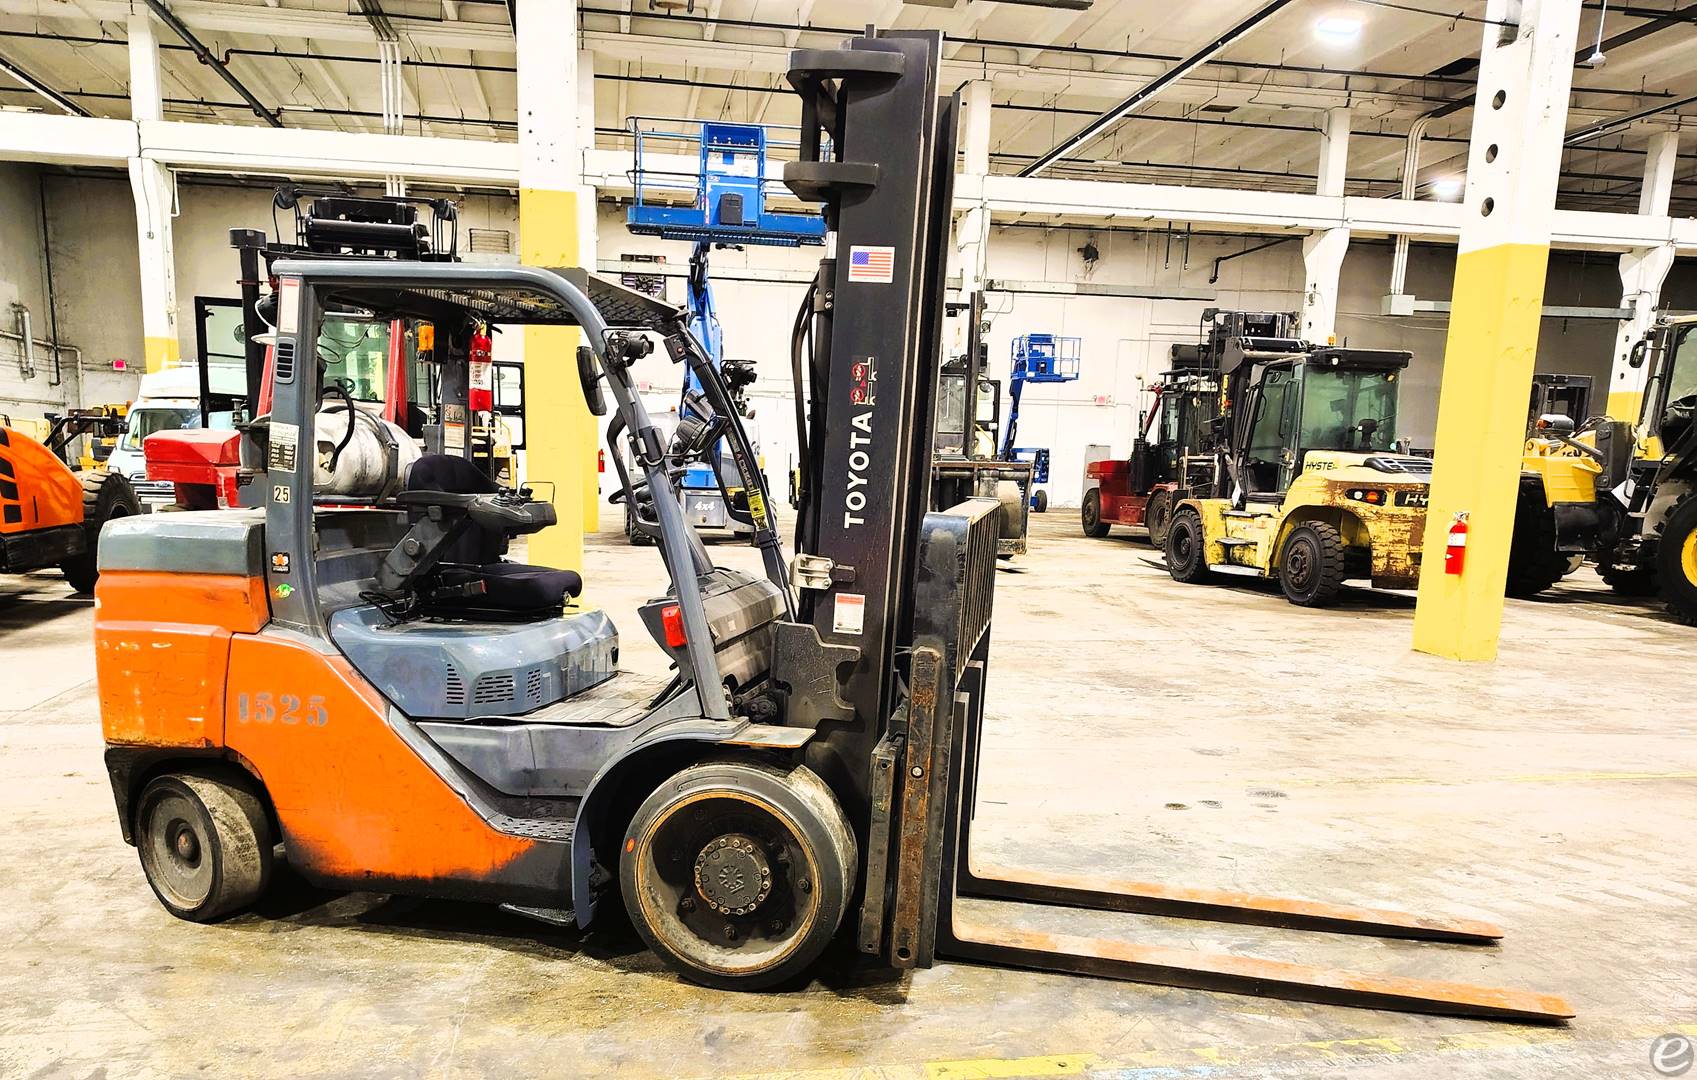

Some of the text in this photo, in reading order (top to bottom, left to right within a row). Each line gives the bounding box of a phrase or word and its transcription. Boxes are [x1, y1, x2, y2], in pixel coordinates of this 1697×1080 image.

[844, 411, 872, 529] TOYOTA
[1305, 461, 1338, 470] HYSTE
[274, 486, 289, 502] 25
[694, 501, 716, 511] 4x4
[238, 692, 329, 728] 1525
